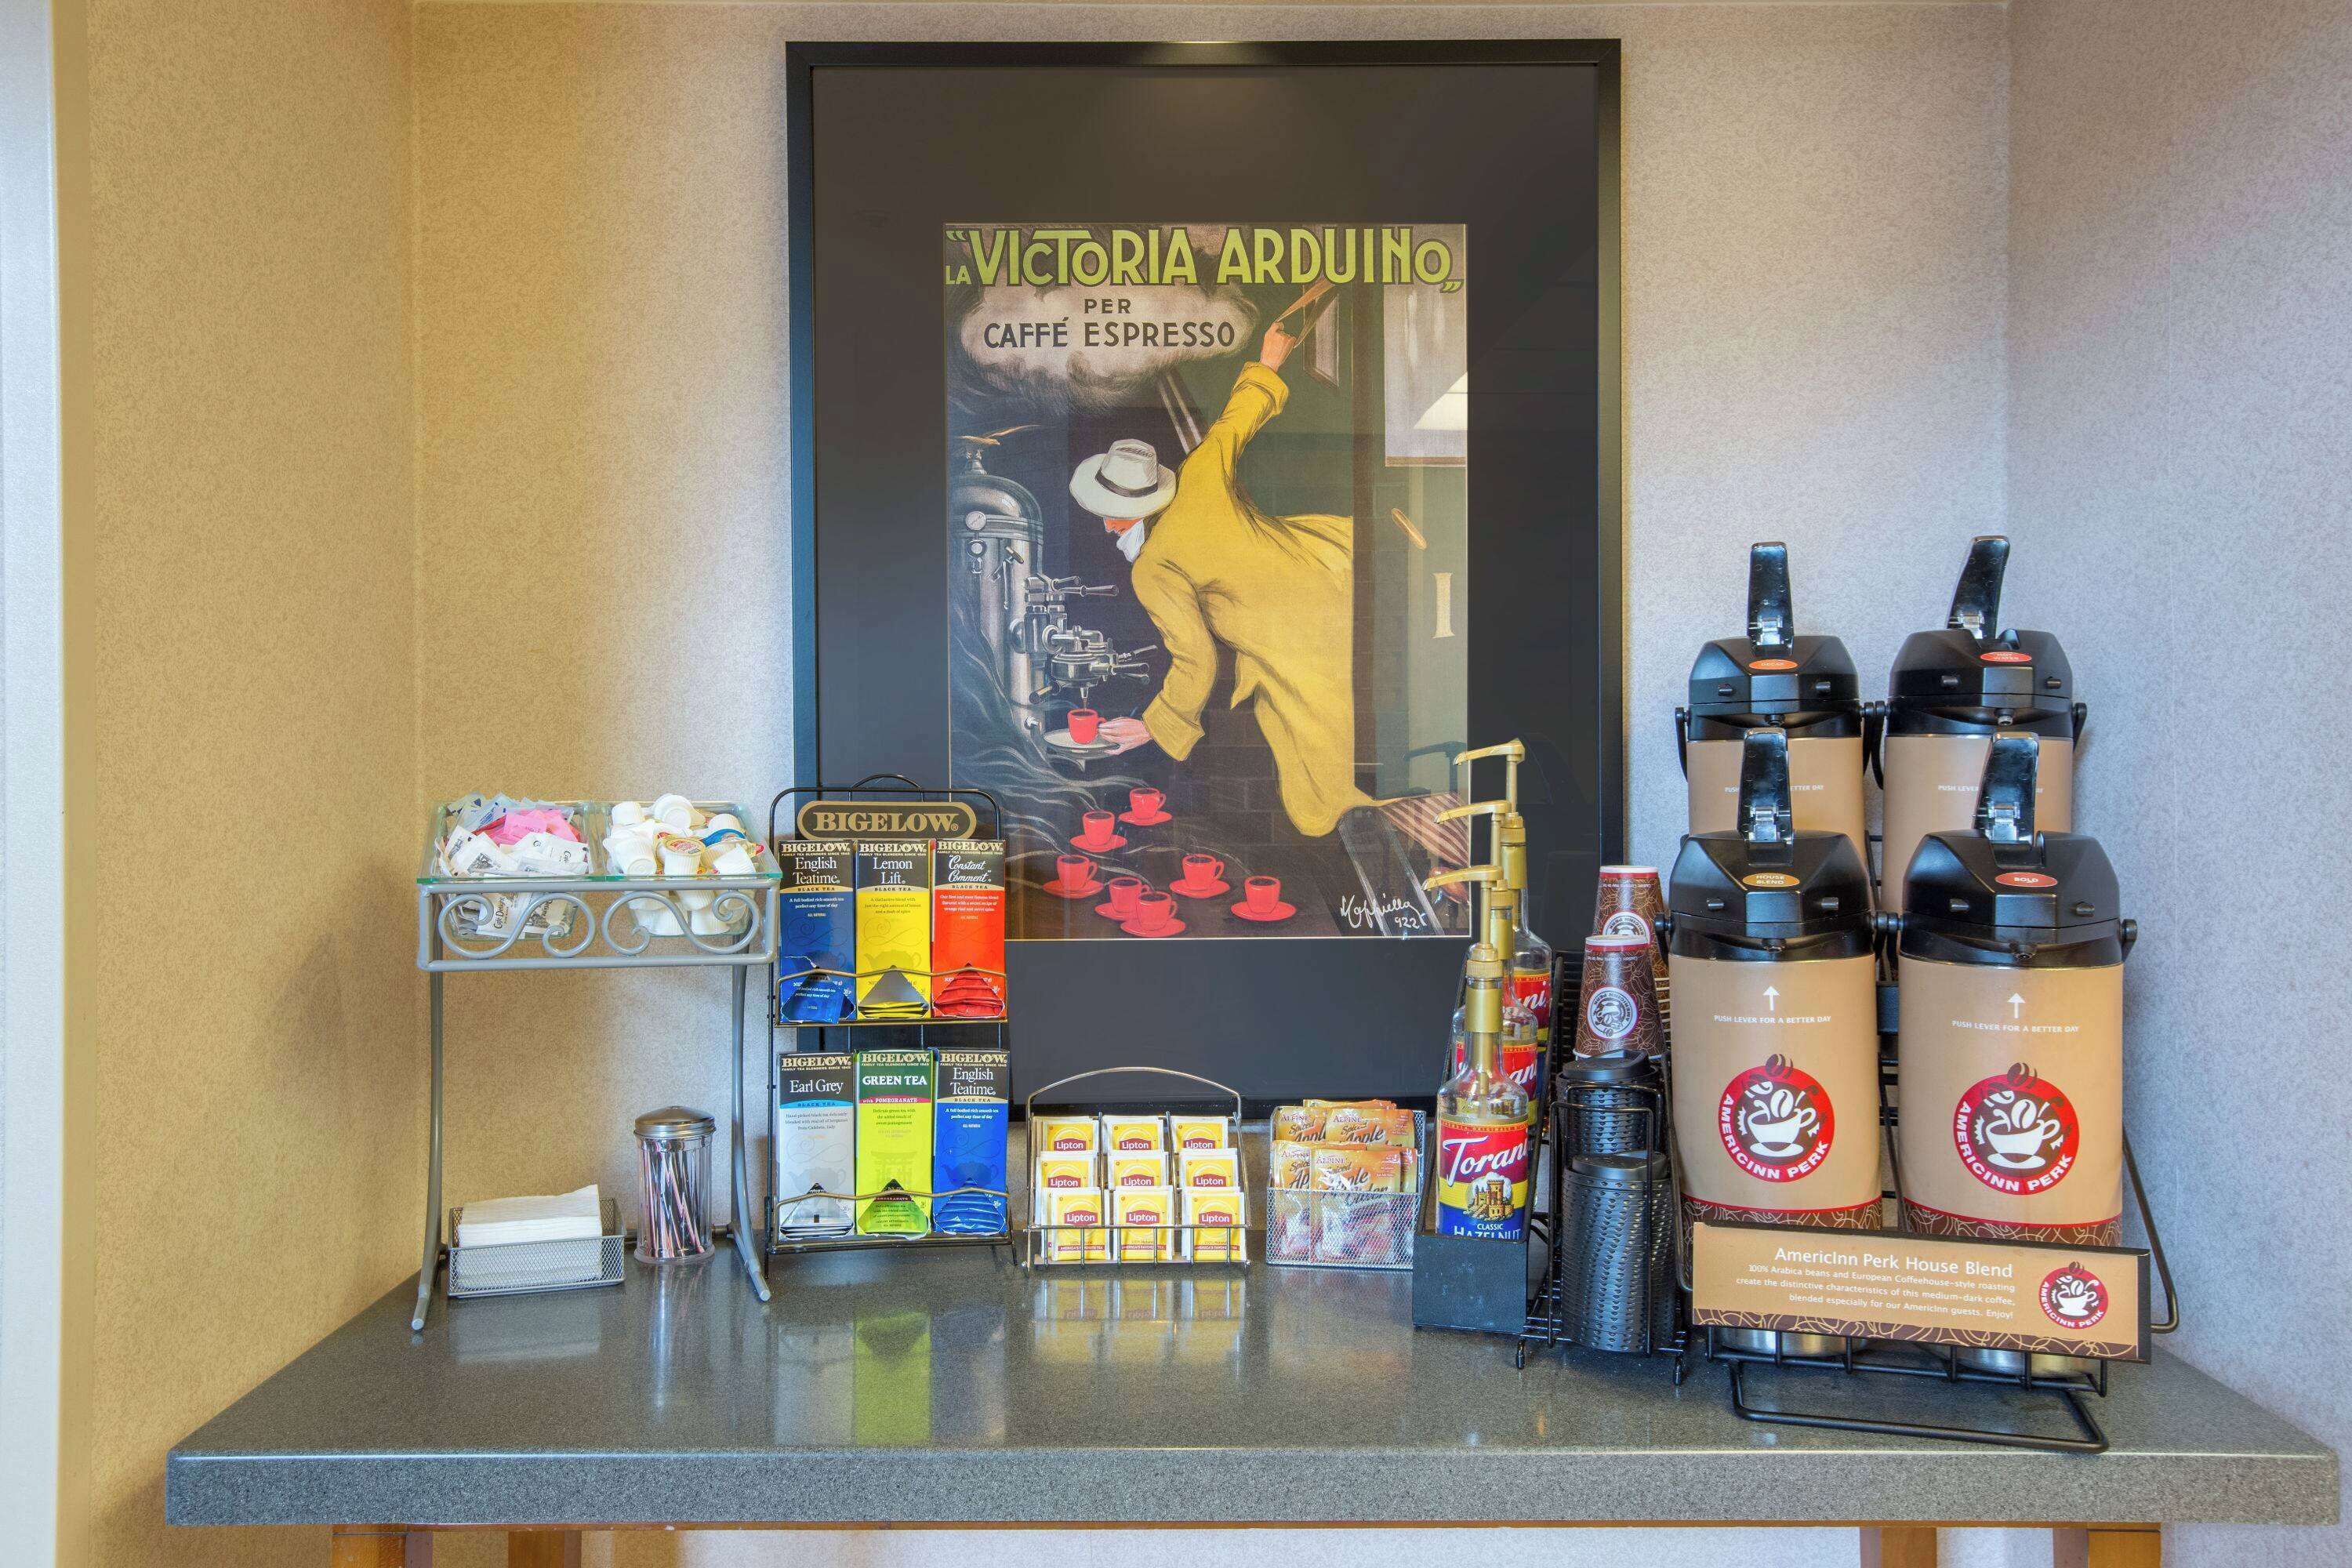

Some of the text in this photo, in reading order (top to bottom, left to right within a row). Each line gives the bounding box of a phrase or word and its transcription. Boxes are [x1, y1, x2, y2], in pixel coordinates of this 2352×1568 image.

[946, 265, 971, 285] LA
[1084, 298, 1131, 314] PER
[983, 317, 1236, 348] CAFFÉ ESPRESSO
[795, 856, 837, 872] English
[873, 857, 913, 869] Lemon
[793, 871, 837, 884] Teatime
[880, 871, 902, 884] Lift
[1974, 1022, 2000, 1031] LEVER
[862, 1075, 927, 1085] GREEN TEA
[953, 1067, 993, 1082] English
[789, 1079, 844, 1094] Earl Grey
[949, 1082, 994, 1096] Teatime
[1721, 1093, 1829, 1179] AMERICINN PERK
[1056, 1141, 1083, 1150] Lipton
[1122, 1141, 1149, 1150] Lipton
[1956, 1101, 2074, 1192] AMERICINN PERK
[1443, 1127, 1528, 1187] Torani
[1050, 1178, 1079, 1187] Lipton
[1123, 1177, 1152, 1186] Lipton
[1196, 1177, 1223, 1186] Lipton
[1067, 1213, 1095, 1224] Lipton
[1128, 1213, 1157, 1223] Lipton
[1201, 1214, 1230, 1224] Lipton
[1774, 1247, 2013, 1278] AmericInn Perk House Blend
[1748, 1264, 2016, 1294] 100% Arabica beans and European Coffeehouse-style roasting
[1736, 1278, 2016, 1306] create the distinctive characteristics of this medium-dark coffee,
[1789, 1294, 1824, 1304] blended
[1826, 1296, 1868, 1308] especially
[1871, 1298, 1884, 1308] for
[1904, 1302, 1948, 1313] AmericInn
[1951, 1308, 1983, 1316] guests.
[1986, 1308, 2014, 1320] Enjoy!
[2041, 1281, 2104, 1328] AMERICINN PERK
